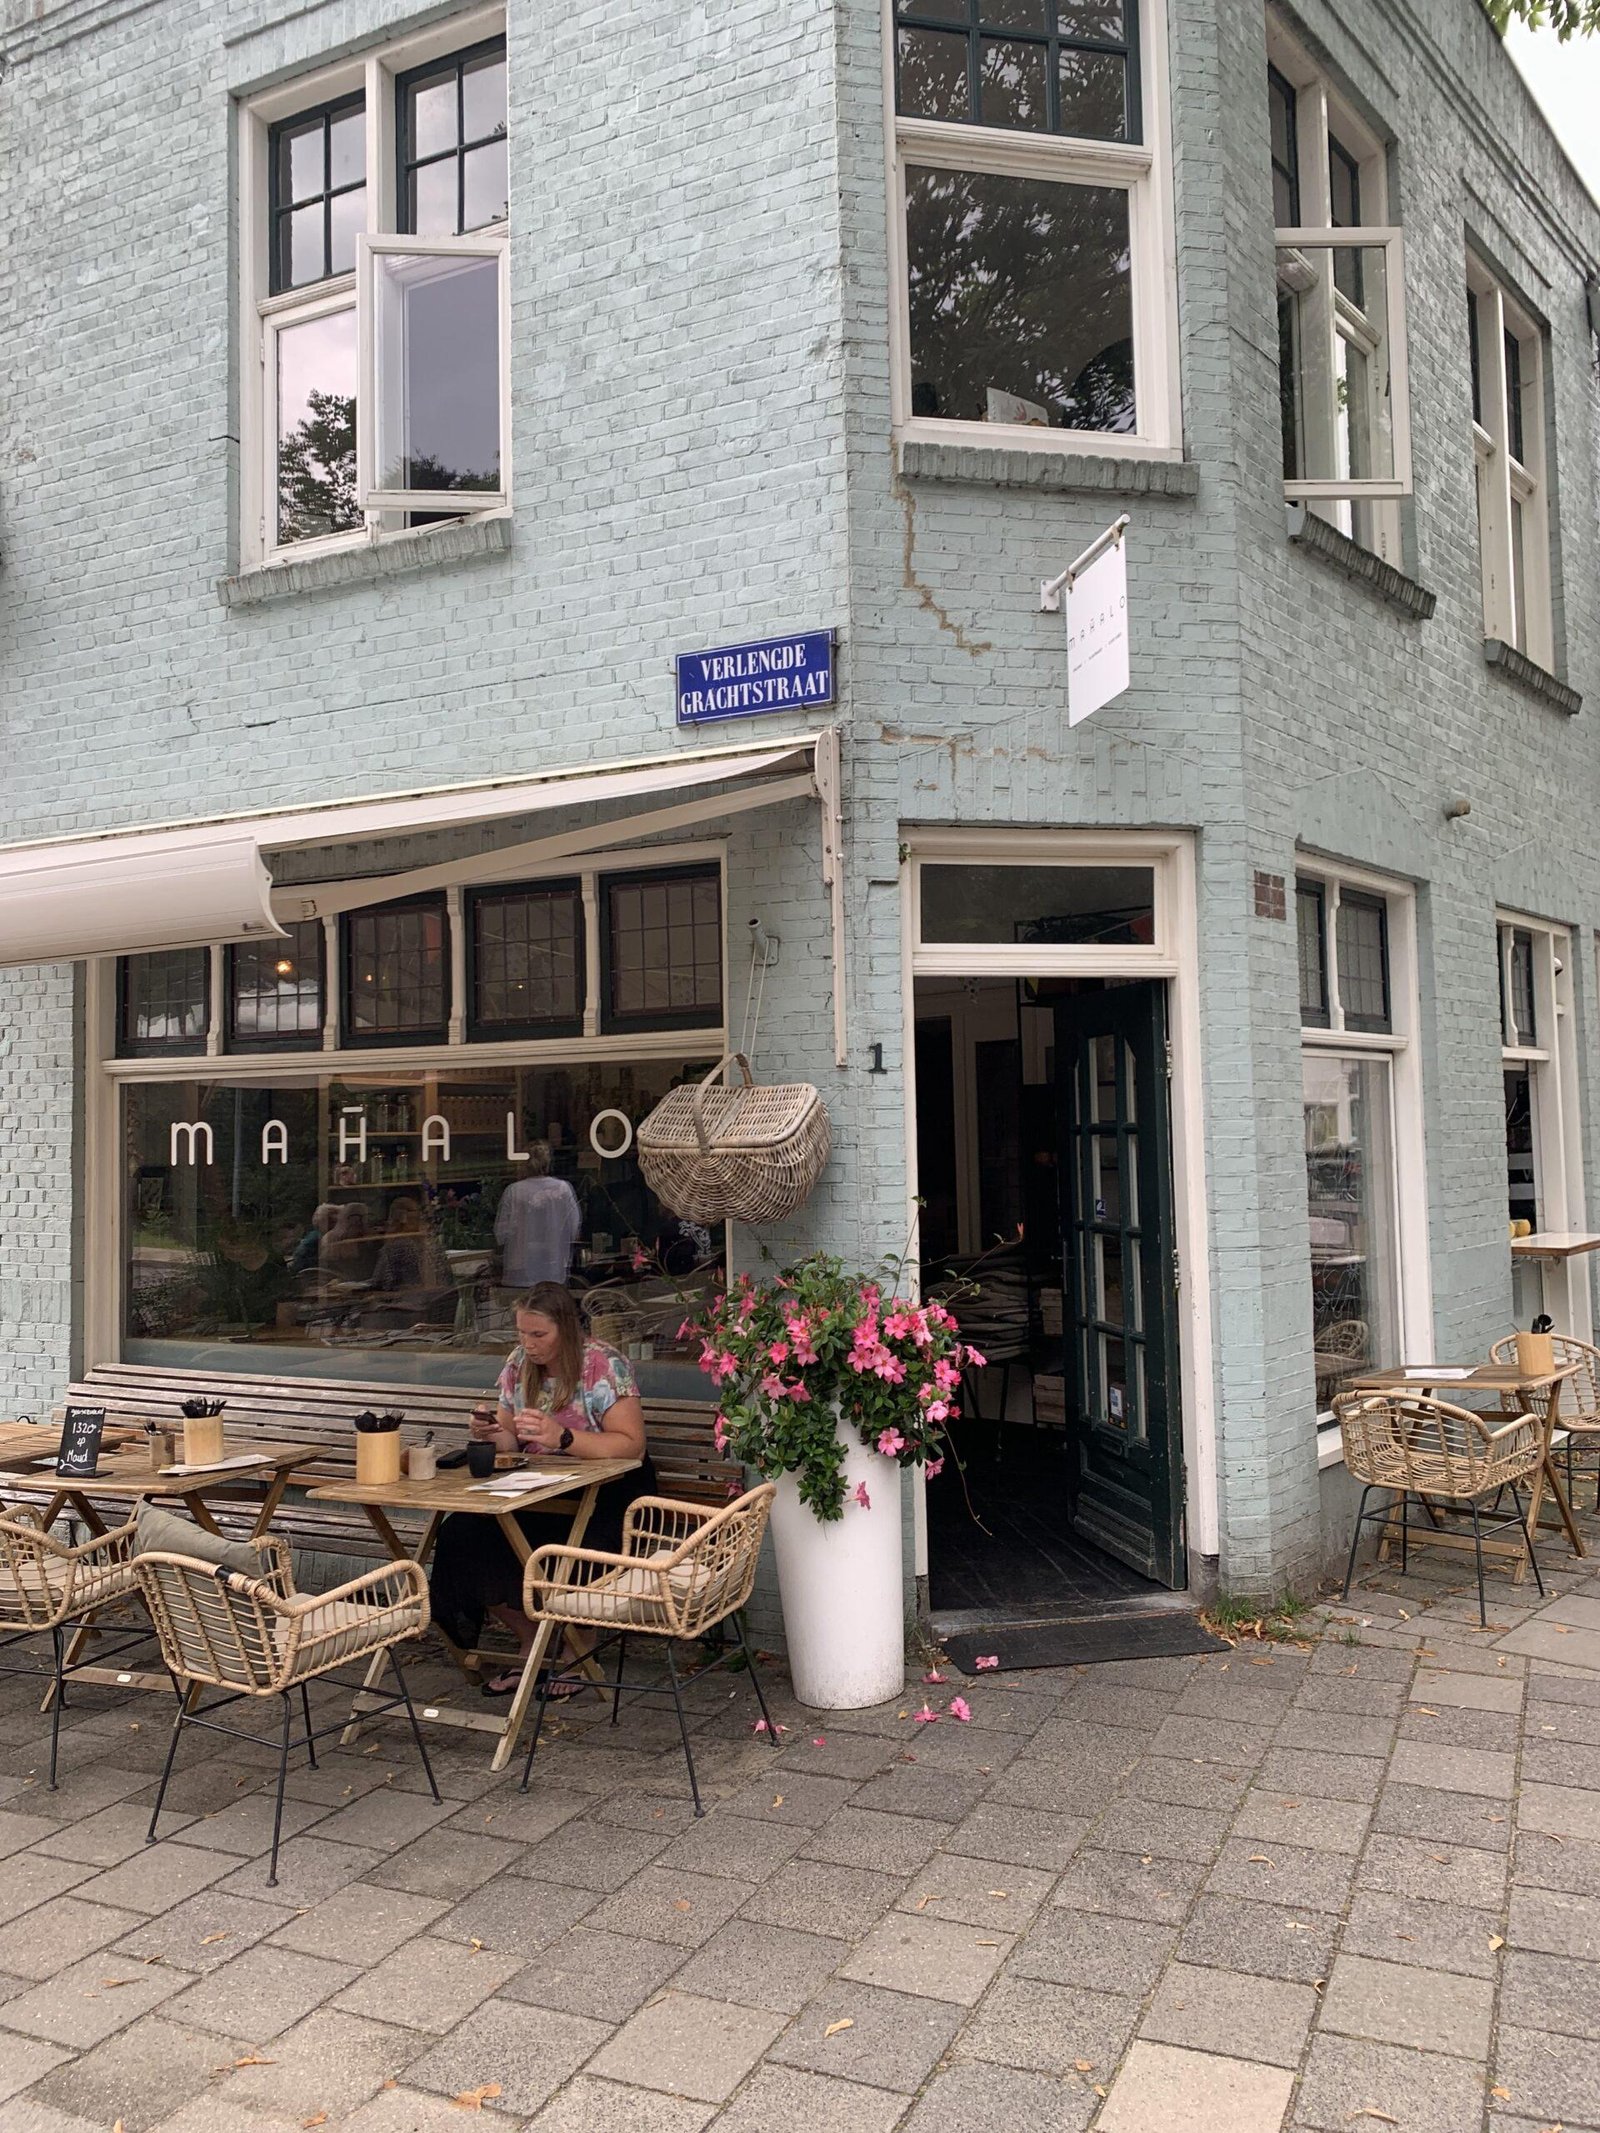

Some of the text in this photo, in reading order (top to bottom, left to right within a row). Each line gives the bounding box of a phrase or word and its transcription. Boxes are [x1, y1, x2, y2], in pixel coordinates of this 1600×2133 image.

[700, 643, 807, 682] VERLENGDE
[680, 670, 829, 715] GRACHTSTRAAT
[868, 1043, 888, 1075] 1
